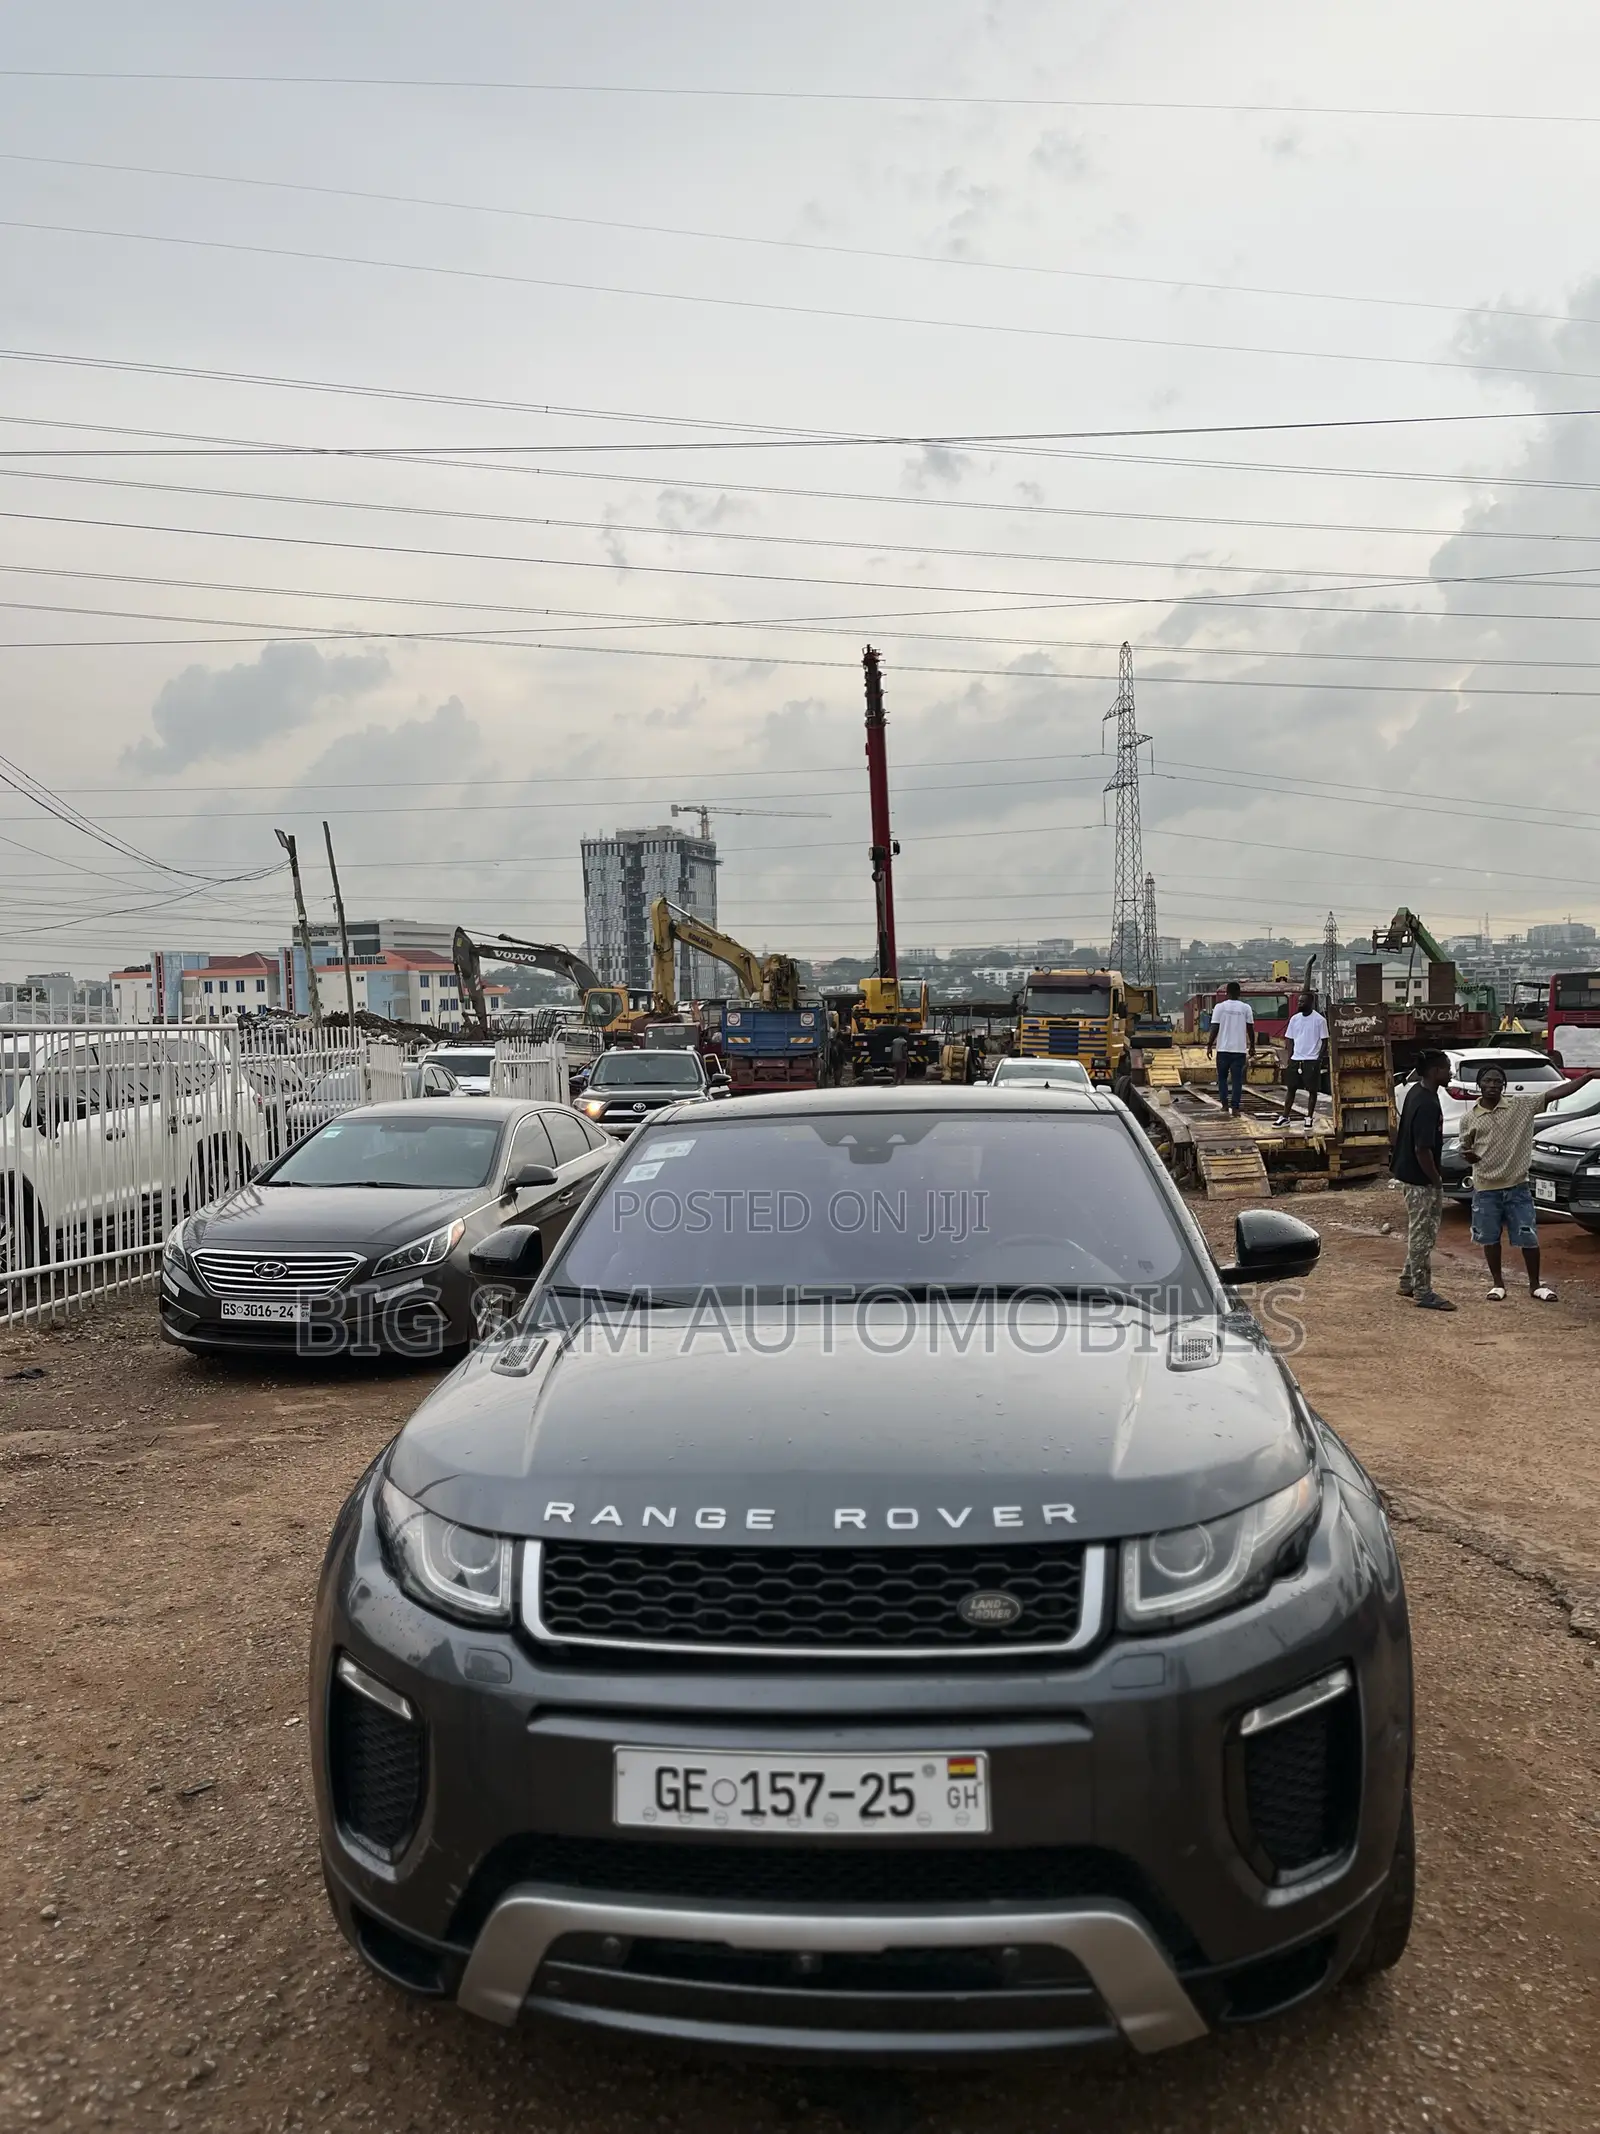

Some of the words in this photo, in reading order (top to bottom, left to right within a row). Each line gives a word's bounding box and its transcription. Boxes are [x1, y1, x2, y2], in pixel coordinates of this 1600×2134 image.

[493, 950, 537, 962] VOLVO
[1414, 1008, 1436, 1021] DRY
[543, 1501, 776, 1530] RANGE
[834, 1503, 1077, 1529] ROVER
[947, 1785, 979, 1810] GH
